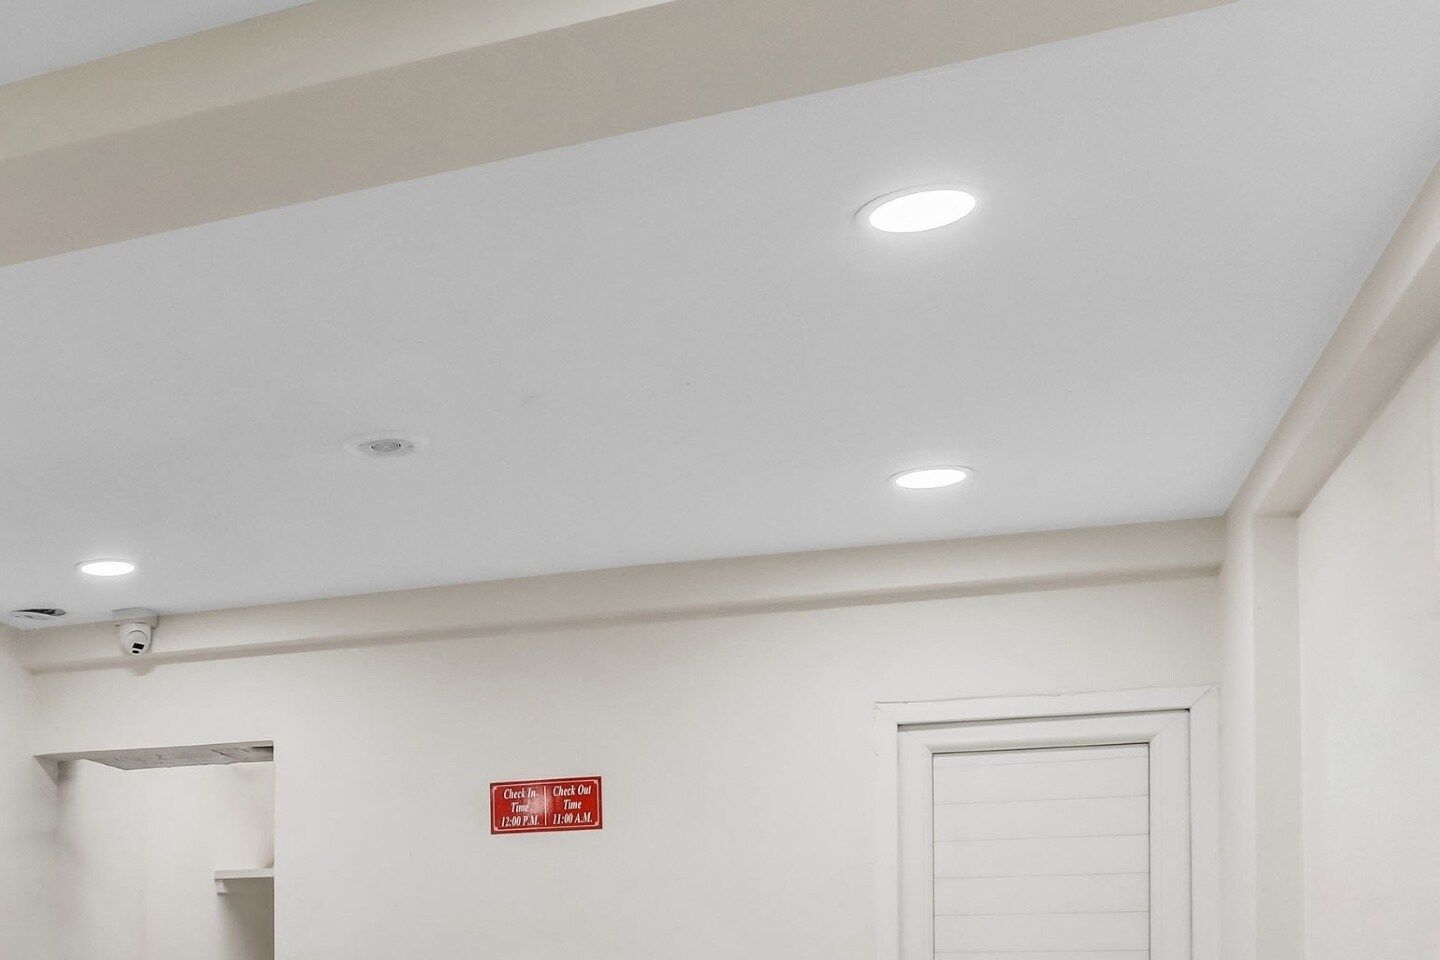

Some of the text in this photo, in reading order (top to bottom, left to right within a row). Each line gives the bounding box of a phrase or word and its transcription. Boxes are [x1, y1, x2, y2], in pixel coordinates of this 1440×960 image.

[503, 787, 525, 799] Check
[553, 784, 591, 796] Check Out
[511, 802, 529, 813] Time
[563, 799, 582, 810] Time
[501, 814, 540, 827] 12:00 P.M.
[553, 811, 593, 825] 11:00 A.M.
